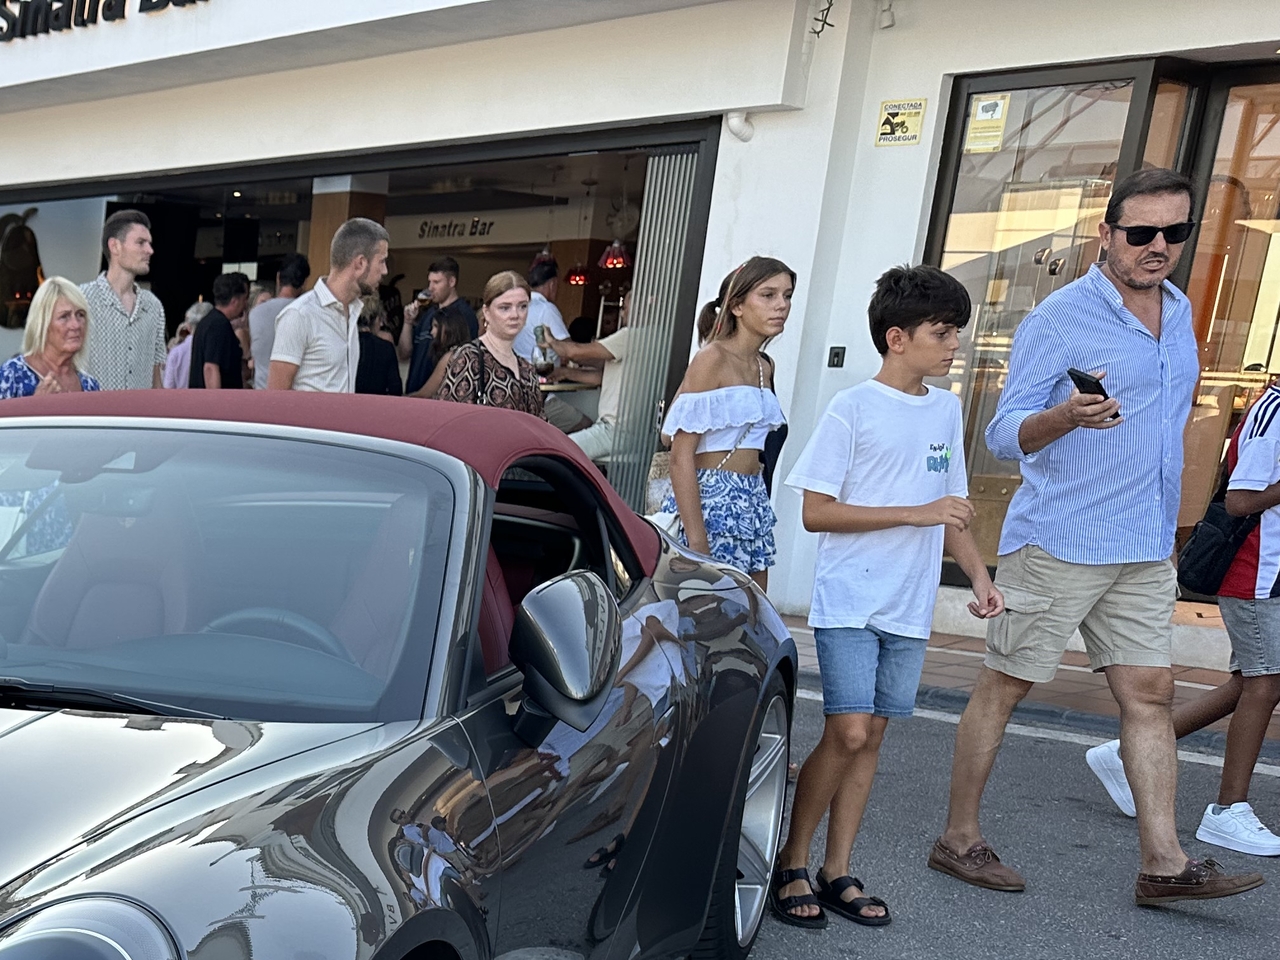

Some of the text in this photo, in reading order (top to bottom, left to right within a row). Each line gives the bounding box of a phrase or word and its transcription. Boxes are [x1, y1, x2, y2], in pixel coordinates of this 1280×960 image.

[883, 101, 923, 112] CONECTADA
[878, 134, 918, 143] PROSEGUR
[418, 217, 495, 239] Sinatra Bar
